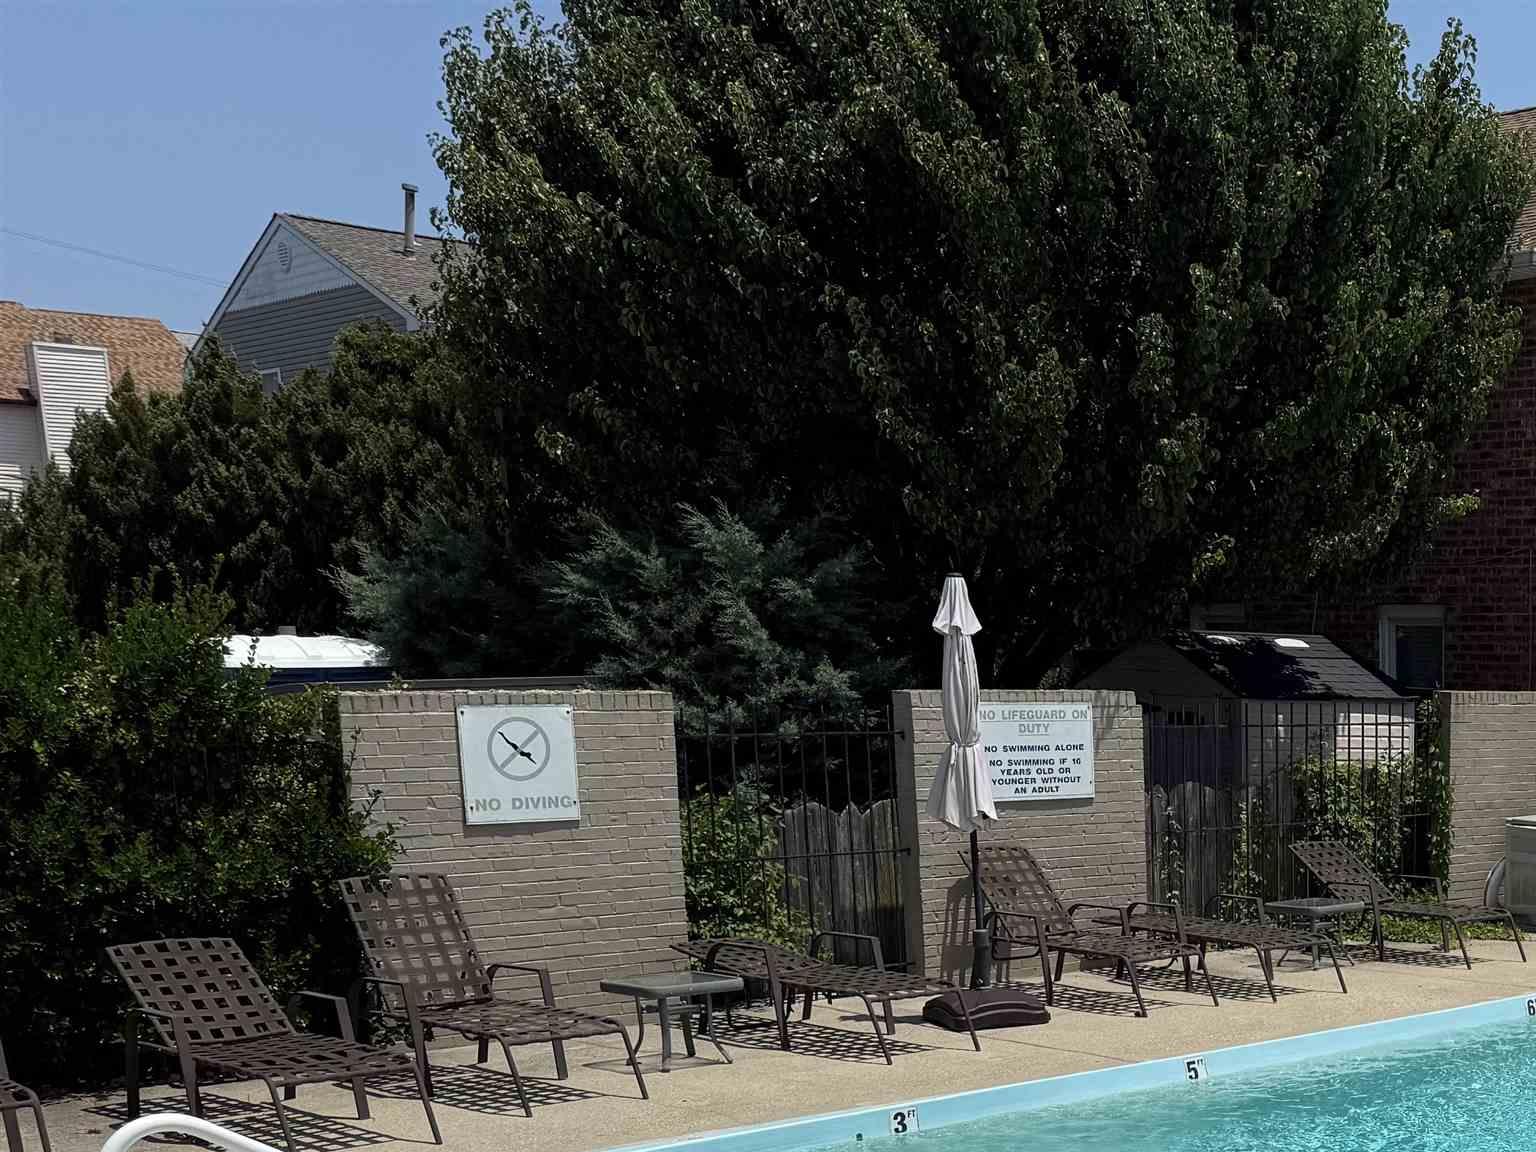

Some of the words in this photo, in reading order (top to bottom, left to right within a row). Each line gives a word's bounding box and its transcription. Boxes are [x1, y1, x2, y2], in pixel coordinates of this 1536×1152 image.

[1001, 709, 1066, 720] LIFEGUARD
[1071, 709, 1088, 720] ON
[1018, 723, 1050, 733] DUTY
[984, 745, 998, 753] NO
[1002, 744, 1050, 753] SWIMMING
[1054, 743, 1085, 751] ALONE
[989, 759, 1003, 767] NO
[1007, 758, 1055, 767] SWIMMING
[1000, 768, 1032, 776] YEARS
[1035, 767, 1054, 775] OLD
[991, 777, 1037, 786] YOUNGER
[1041, 776, 1081, 784] WITHOUT
[1014, 787, 1027, 795] AN
[1031, 786, 1060, 794] ADULT
[474, 799, 501, 811] NO
[511, 796, 573, 810] DIVING
[1527, 999, 1536, 1016] 6
[1186, 1060, 1199, 1080] 5
[893, 1111, 908, 1134] 3
[907, 1109, 915, 1118] FT
